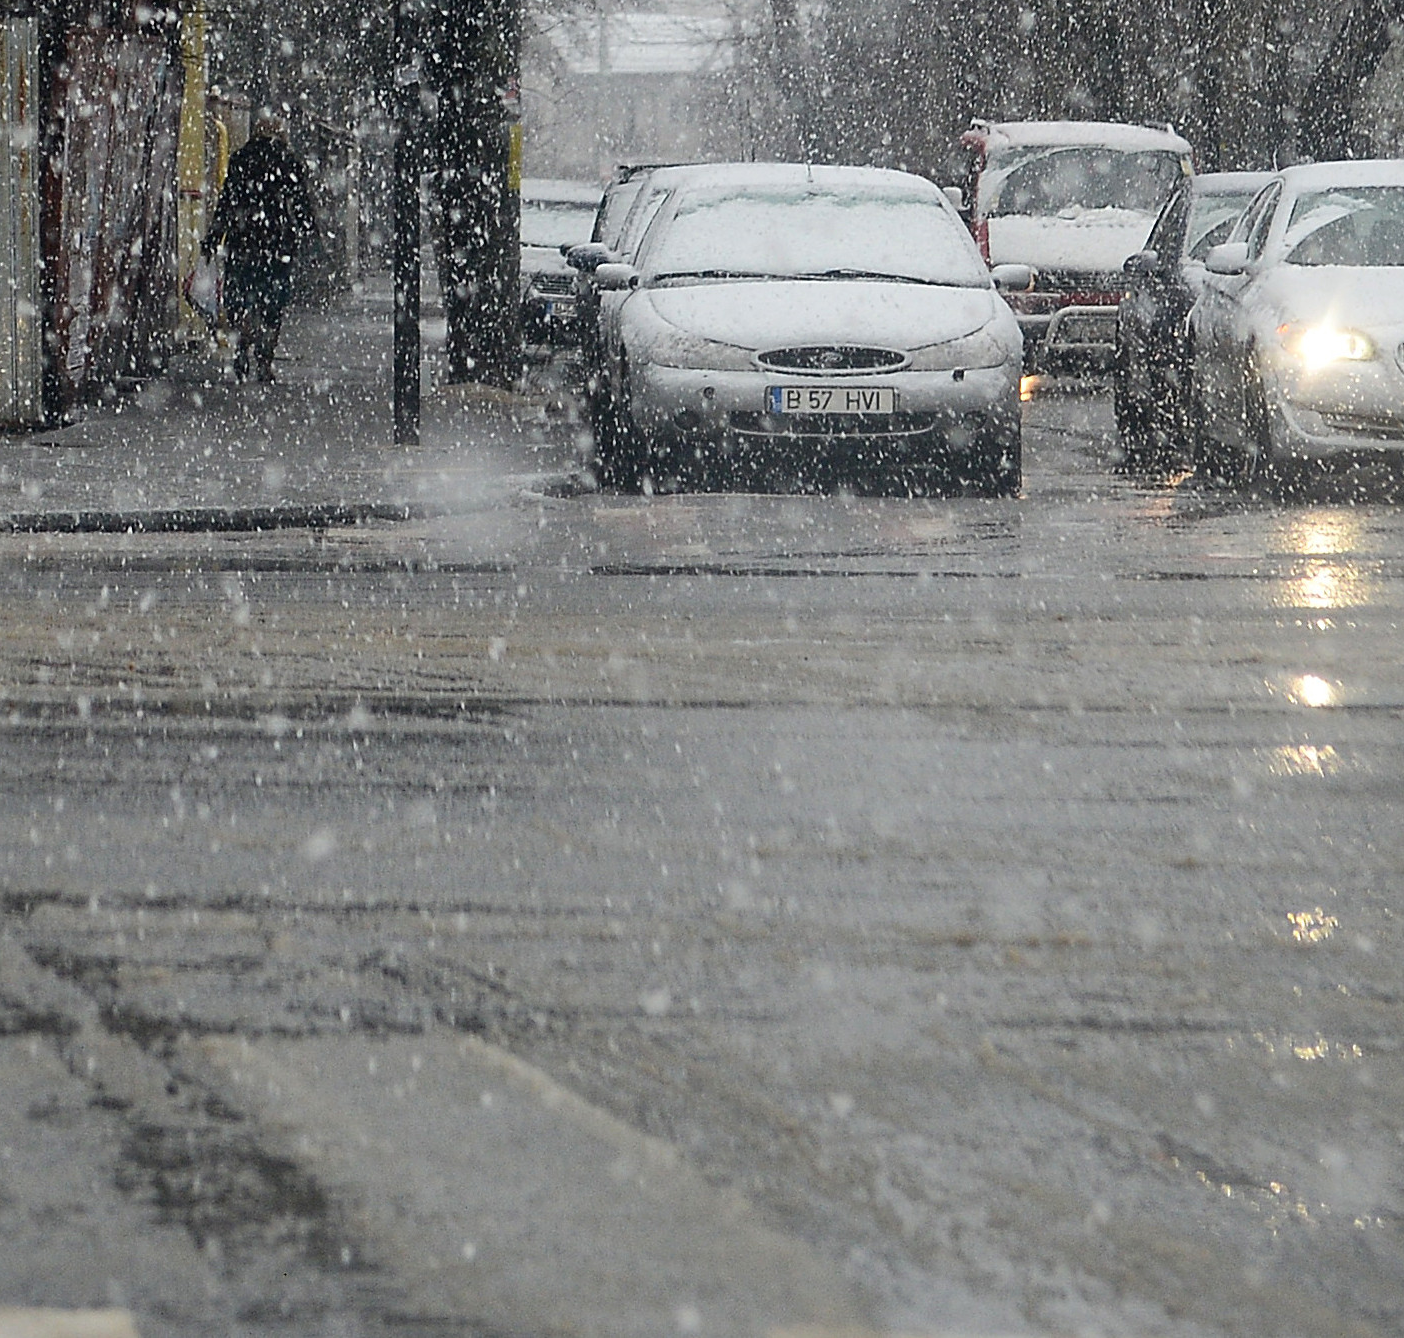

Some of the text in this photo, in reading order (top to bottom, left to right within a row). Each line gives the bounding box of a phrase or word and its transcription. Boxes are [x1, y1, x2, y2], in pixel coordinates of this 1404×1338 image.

[786, 391, 881, 410] B 57 HVI
